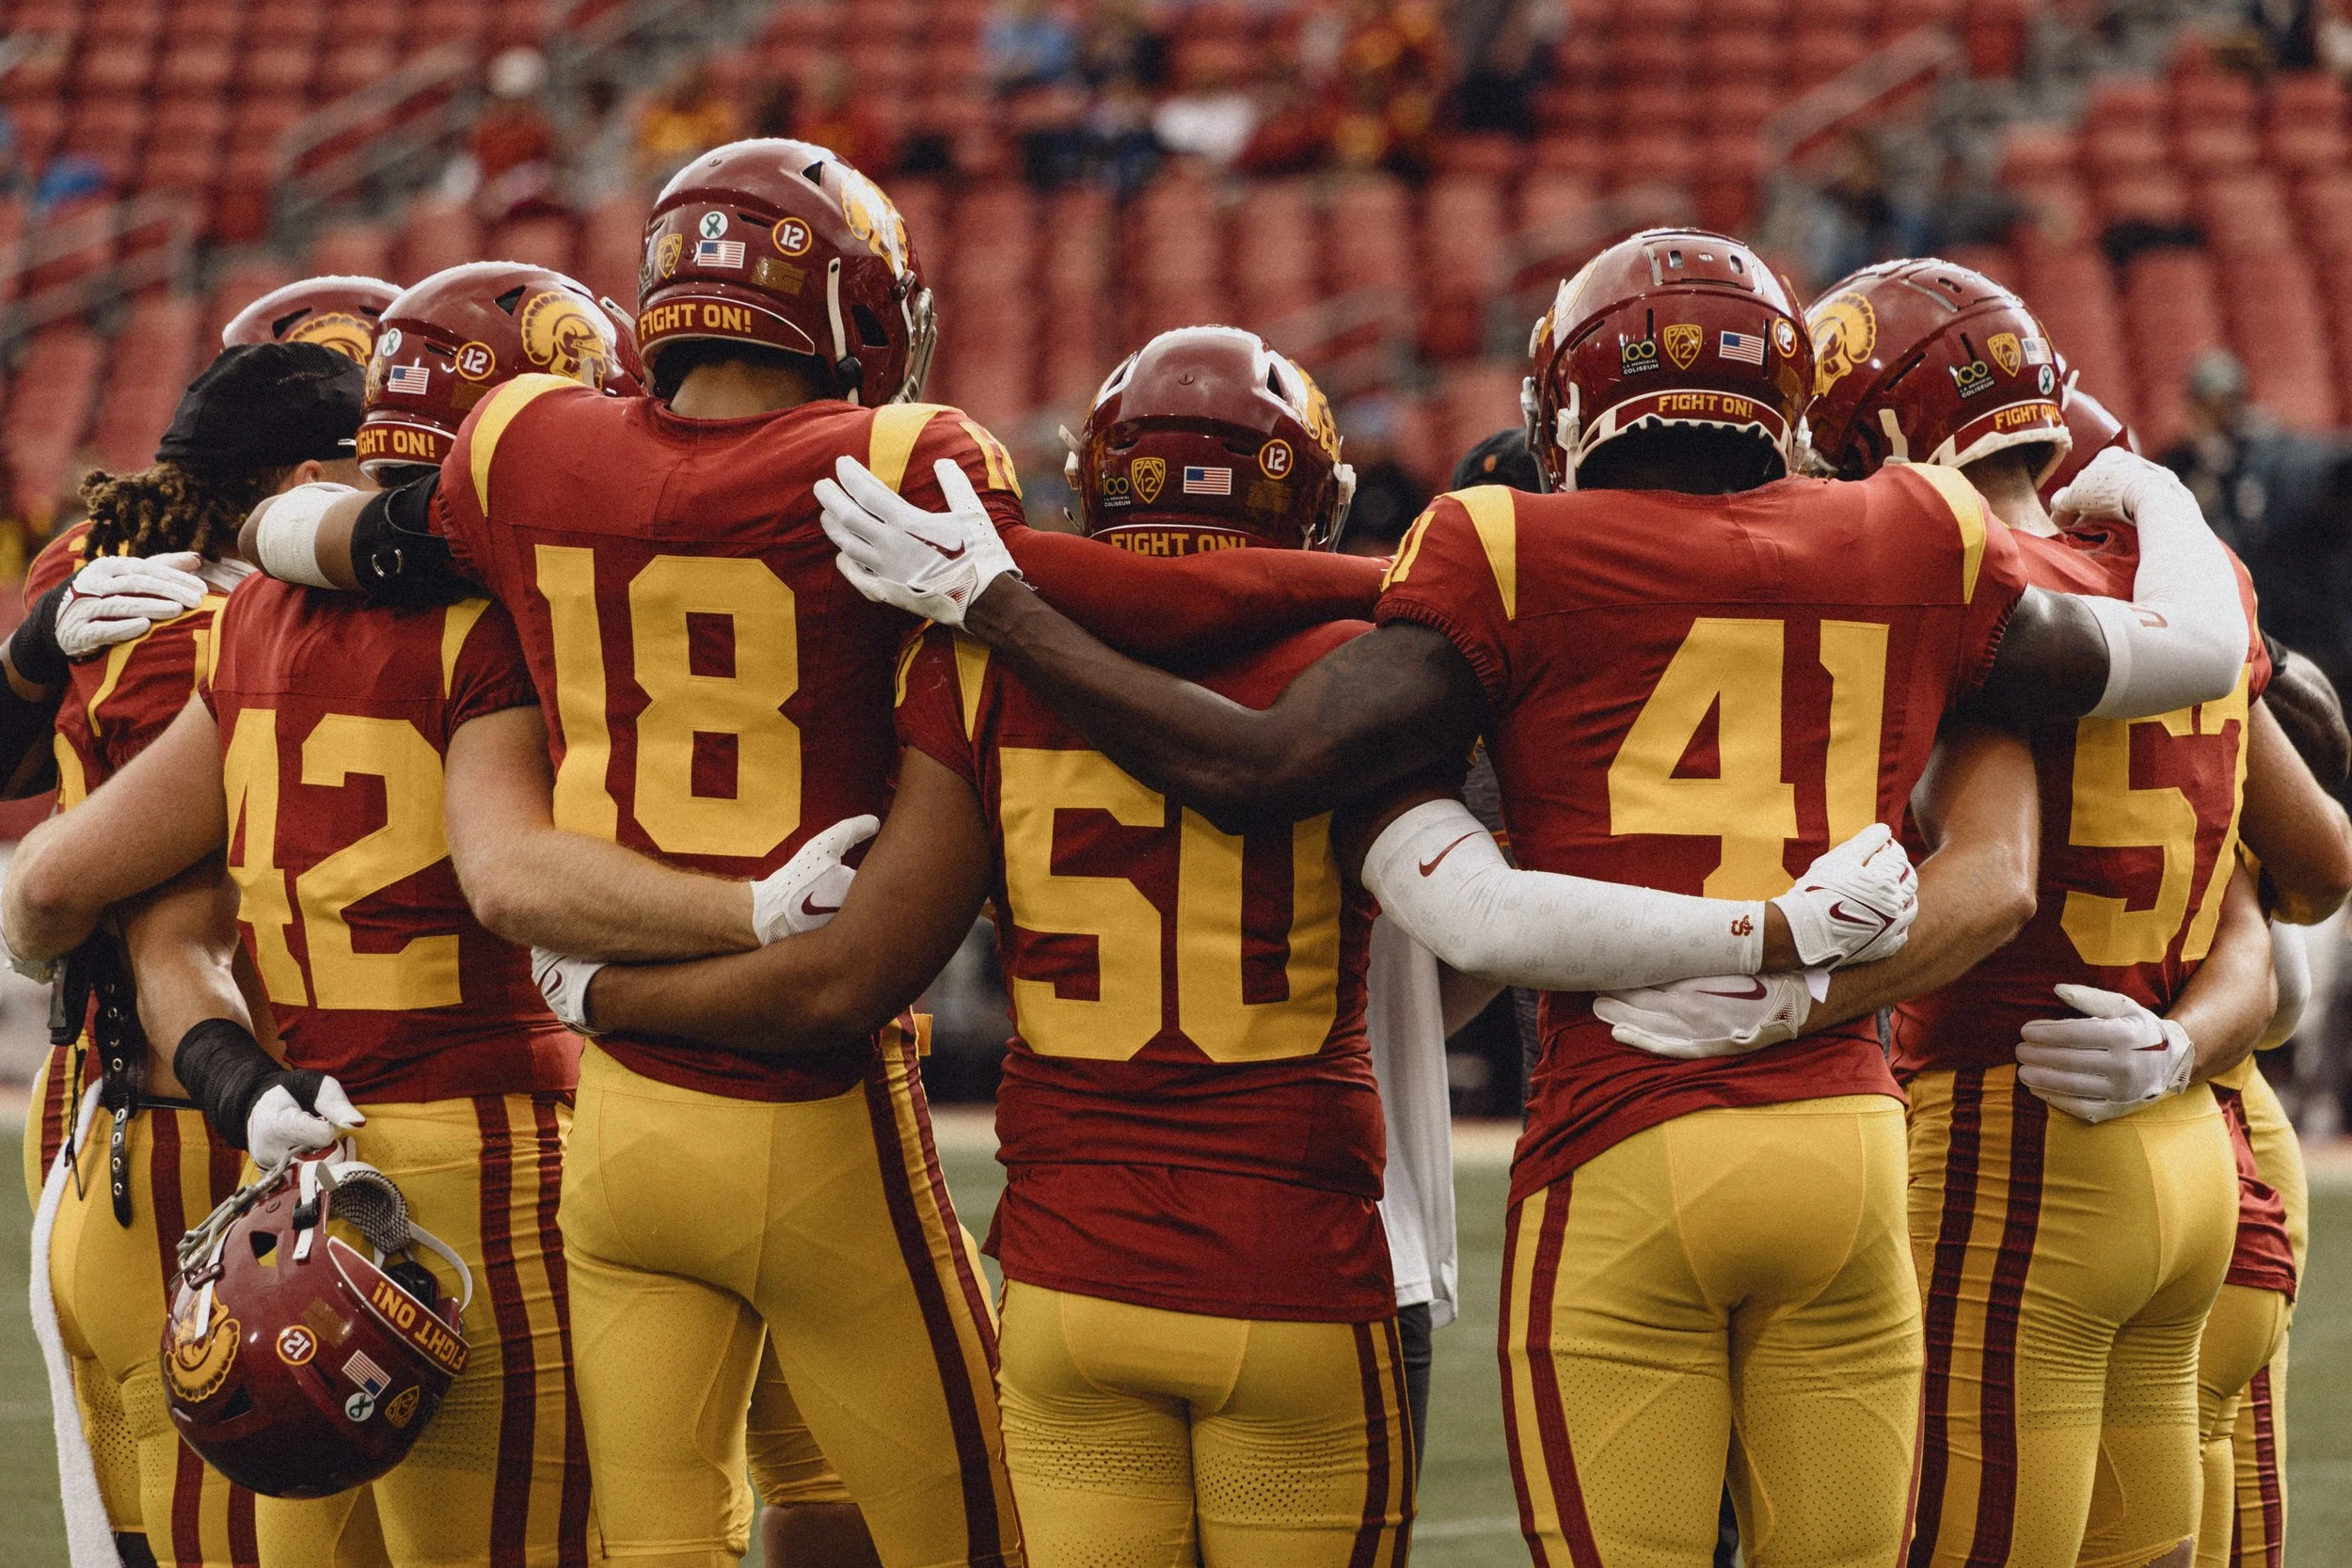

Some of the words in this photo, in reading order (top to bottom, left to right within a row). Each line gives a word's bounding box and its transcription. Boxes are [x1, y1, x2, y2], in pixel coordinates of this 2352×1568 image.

[781, 224, 804, 249] 12
[640, 304, 696, 341] FIGHT
[703, 304, 752, 333] ON!
[1620, 337, 1657, 363] 100
[1667, 327, 1699, 351] PAC
[1675, 343, 1692, 358] 12
[462, 347, 487, 374] 12
[1623, 363, 1659, 374] COLISEUM
[1962, 380, 1995, 399] COLISEUM
[1657, 393, 1718, 413] FIGHT
[1722, 397, 1754, 419] ON!
[1994, 404, 2039, 430] FIGHT
[392, 430, 436, 458] ON!
[1134, 460, 1163, 483] PAC
[1267, 447, 1287, 471] 12
[1140, 477, 1156, 493] 12
[1110, 532, 1190, 556] FIGHT
[534, 544, 803, 859] 18
[1607, 617, 1890, 902] 41
[225, 708, 463, 1010] 42
[999, 747, 1343, 1063] 50
[371, 1280, 417, 1329] ON!
[283, 1331, 311, 1360] 12
[413, 1320, 468, 1370] FIGHT
